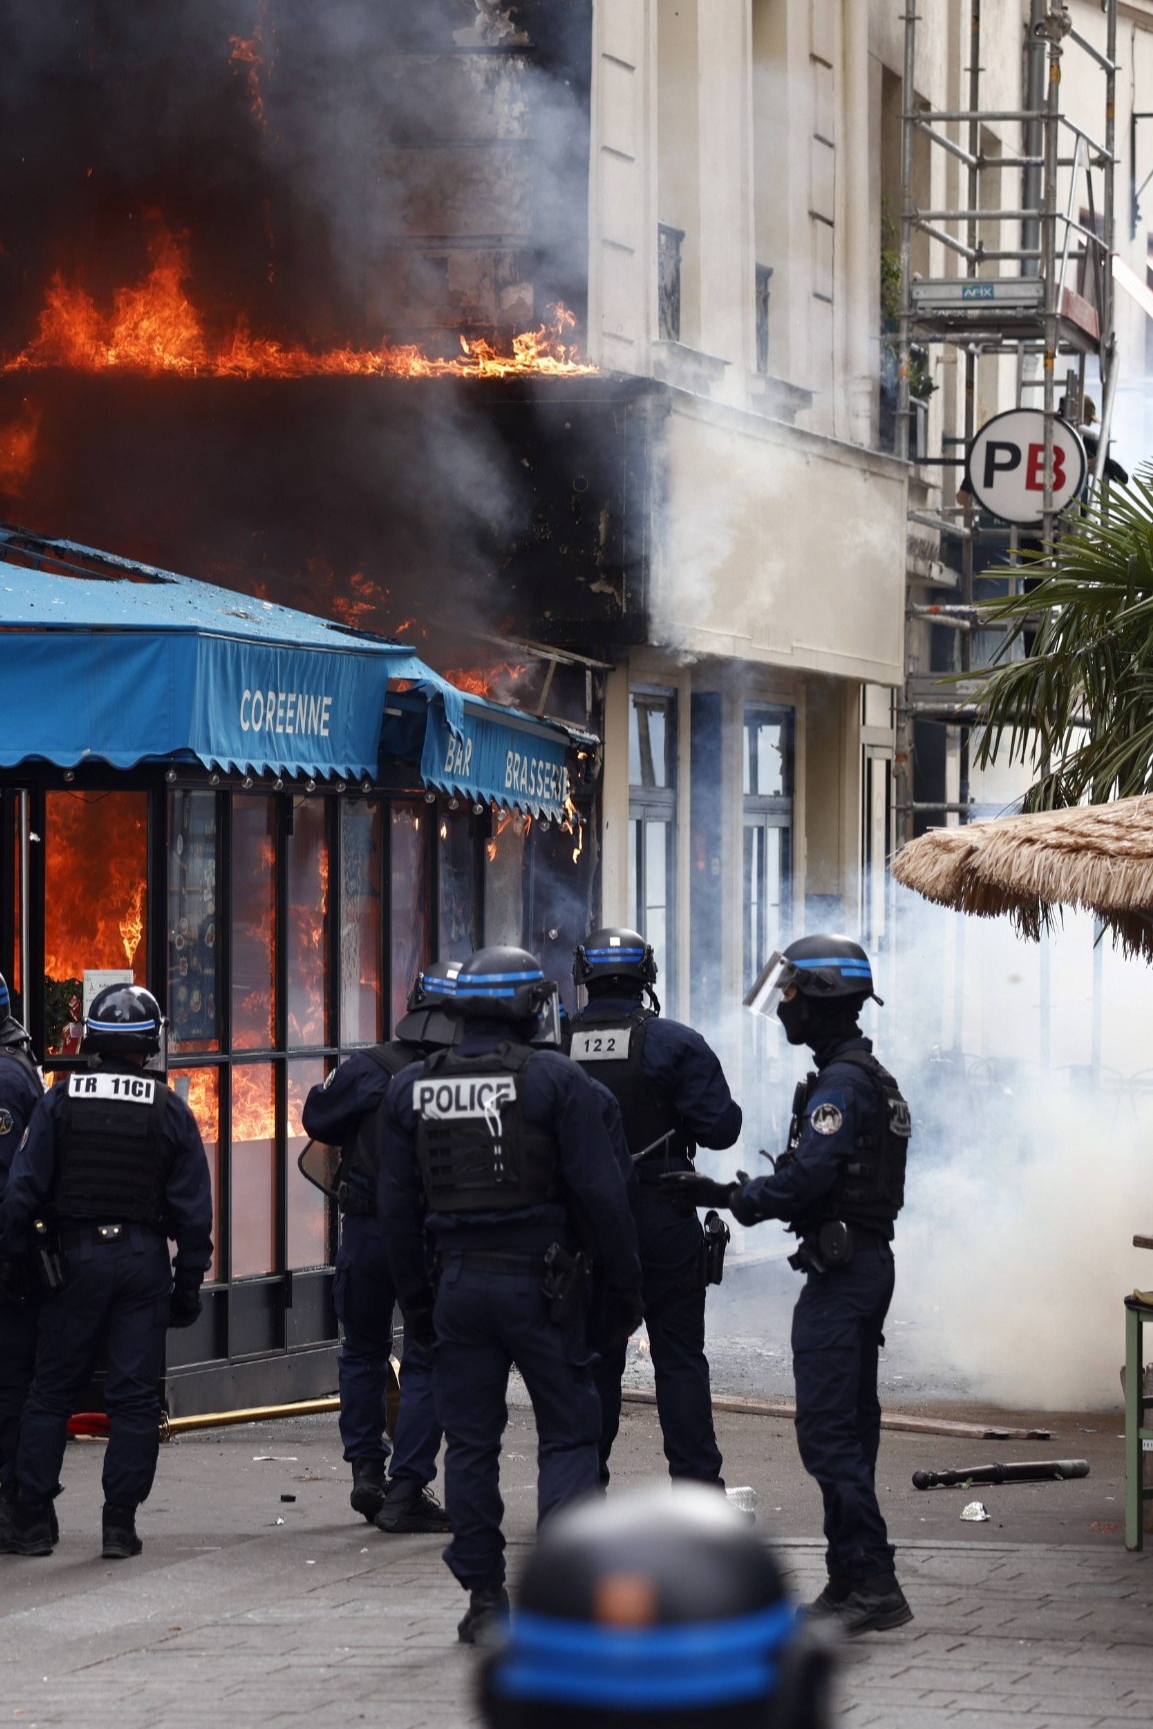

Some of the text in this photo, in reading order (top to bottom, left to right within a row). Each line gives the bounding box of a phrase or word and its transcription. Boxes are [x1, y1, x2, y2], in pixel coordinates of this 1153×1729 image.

[983, 440, 1066, 493] PB
[240, 688, 333, 737] COREENNE
[444, 733, 473, 777] BAR
[73, 1077, 98, 1093] TR
[419, 1082, 512, 1114] POLICE
